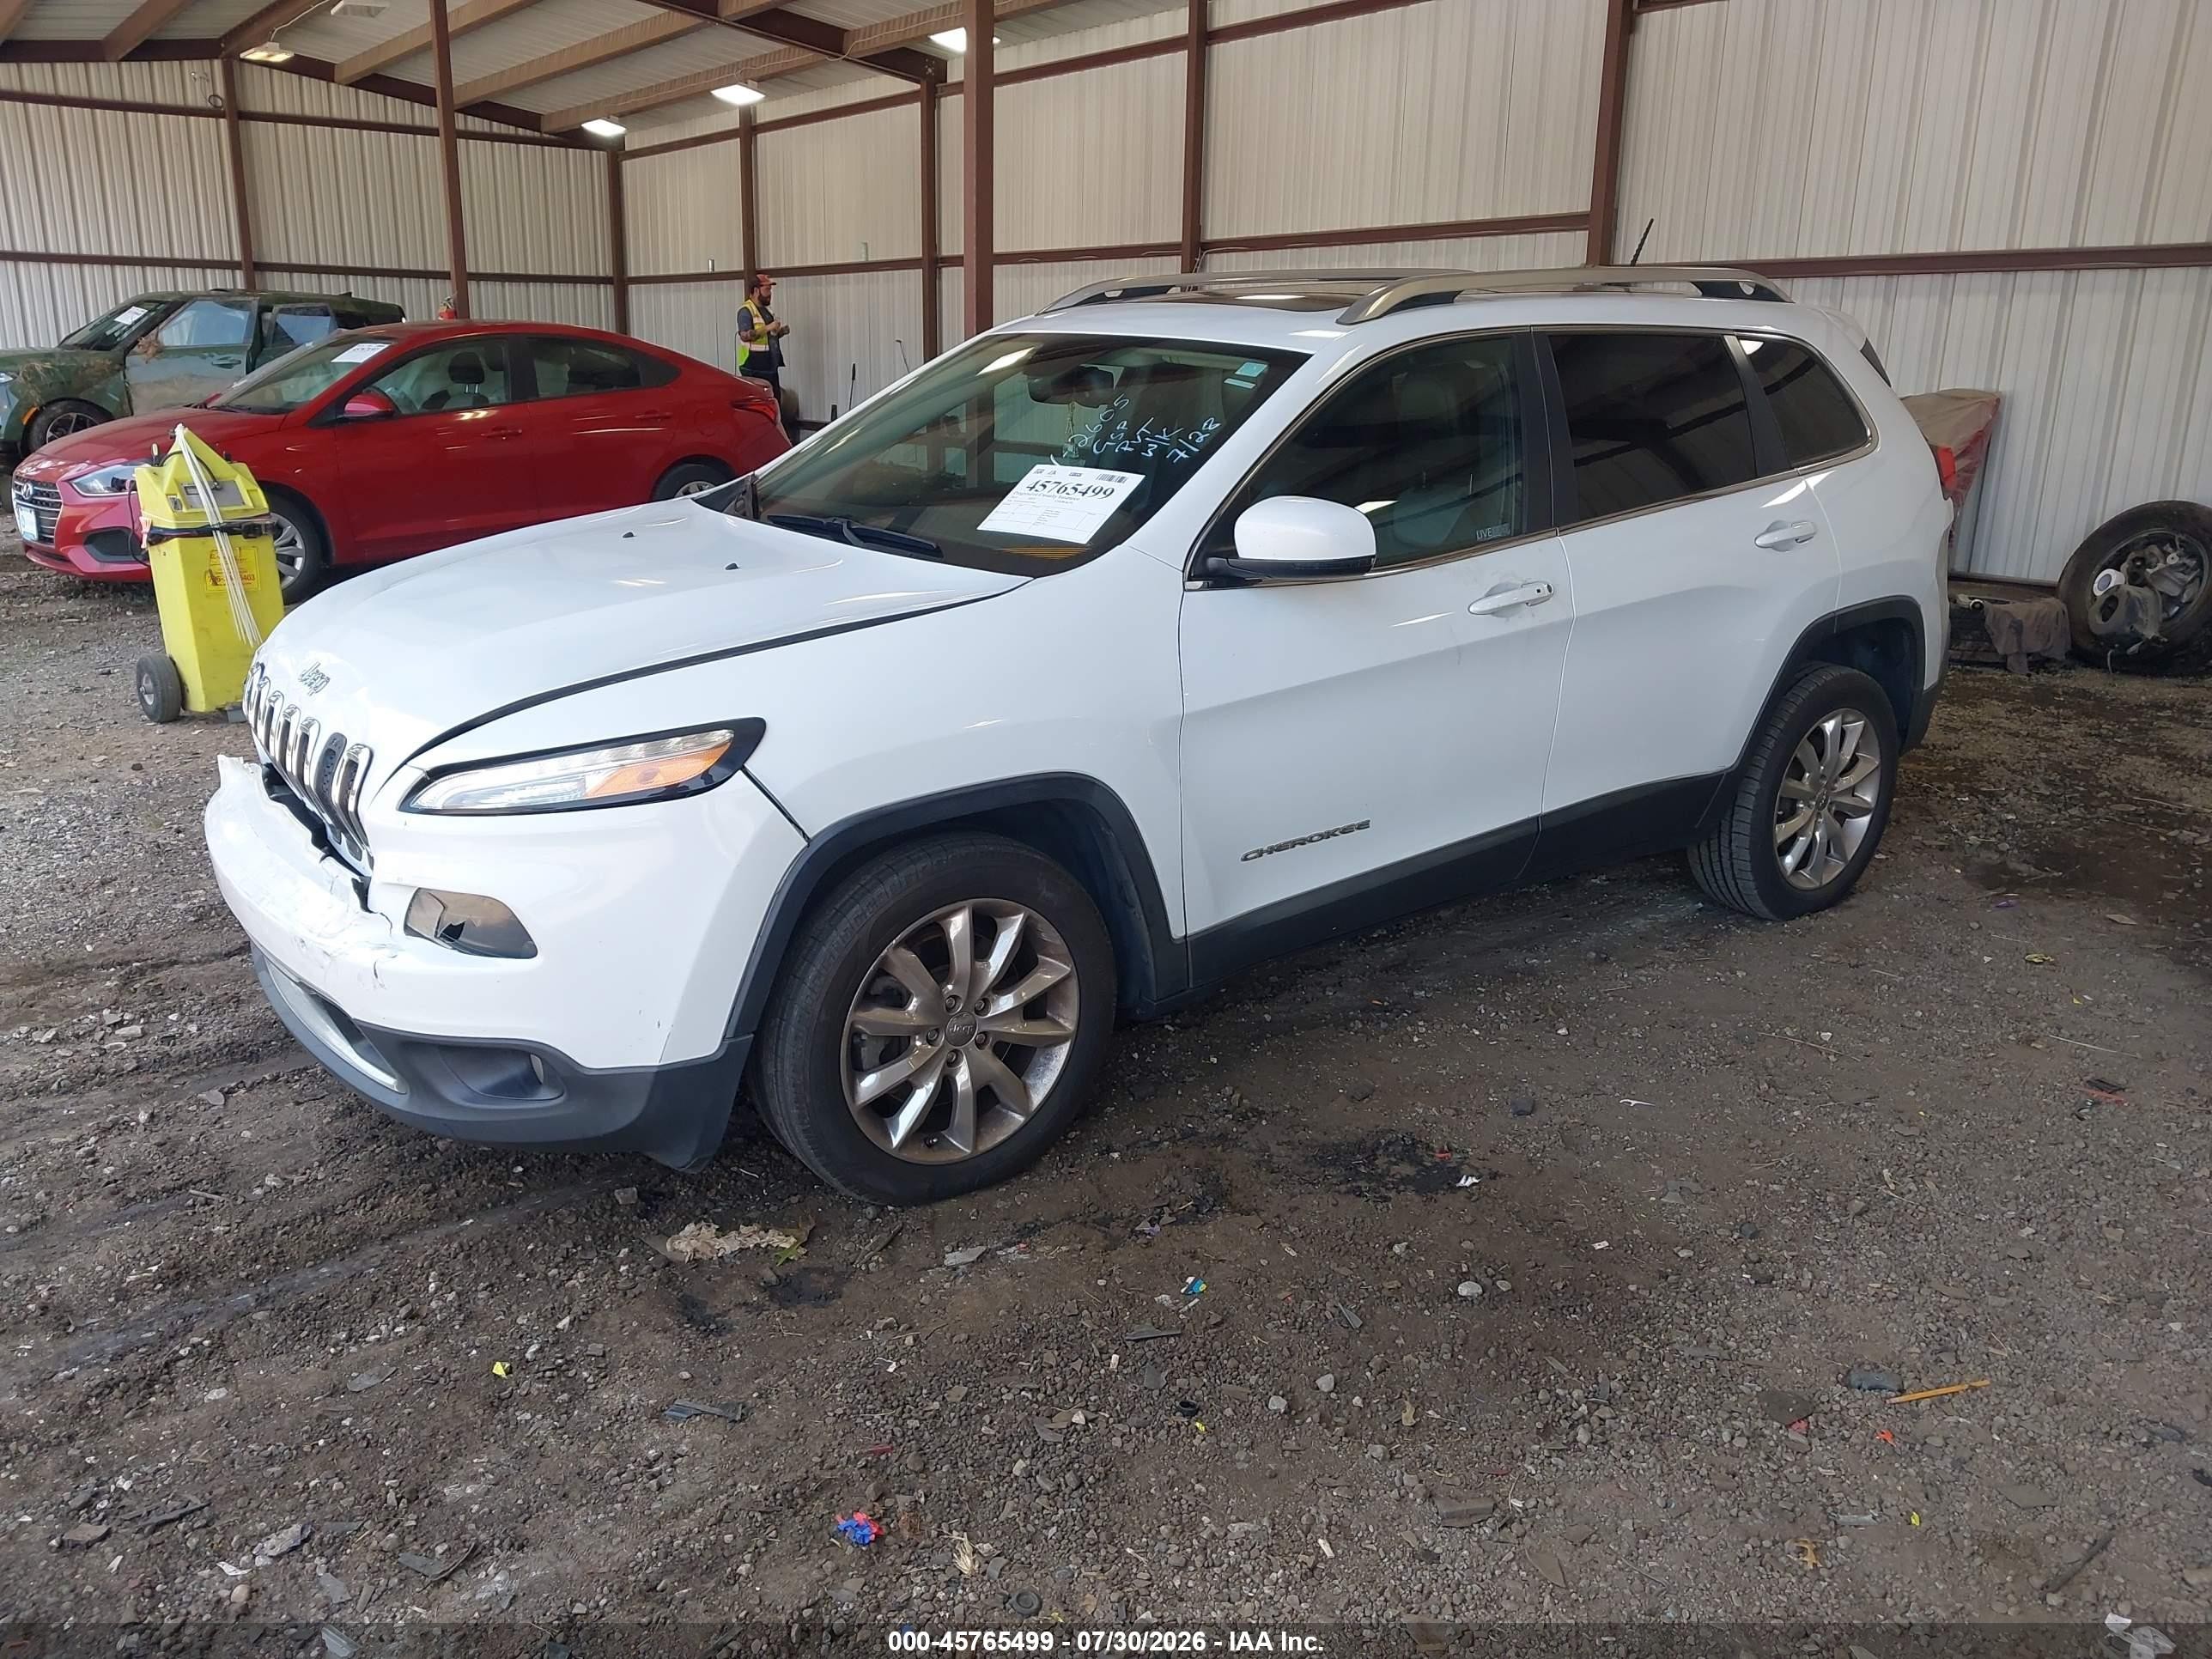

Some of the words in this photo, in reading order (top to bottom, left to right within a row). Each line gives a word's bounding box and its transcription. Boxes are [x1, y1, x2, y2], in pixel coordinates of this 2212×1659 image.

[1141, 428, 1184, 457] W/K
[1166, 417, 1221, 463] 7/28
[1026, 479, 1115, 500] 45765499
[299, 661, 331, 696] Jeep
[1241, 819, 1371, 862] CHEROKEE
